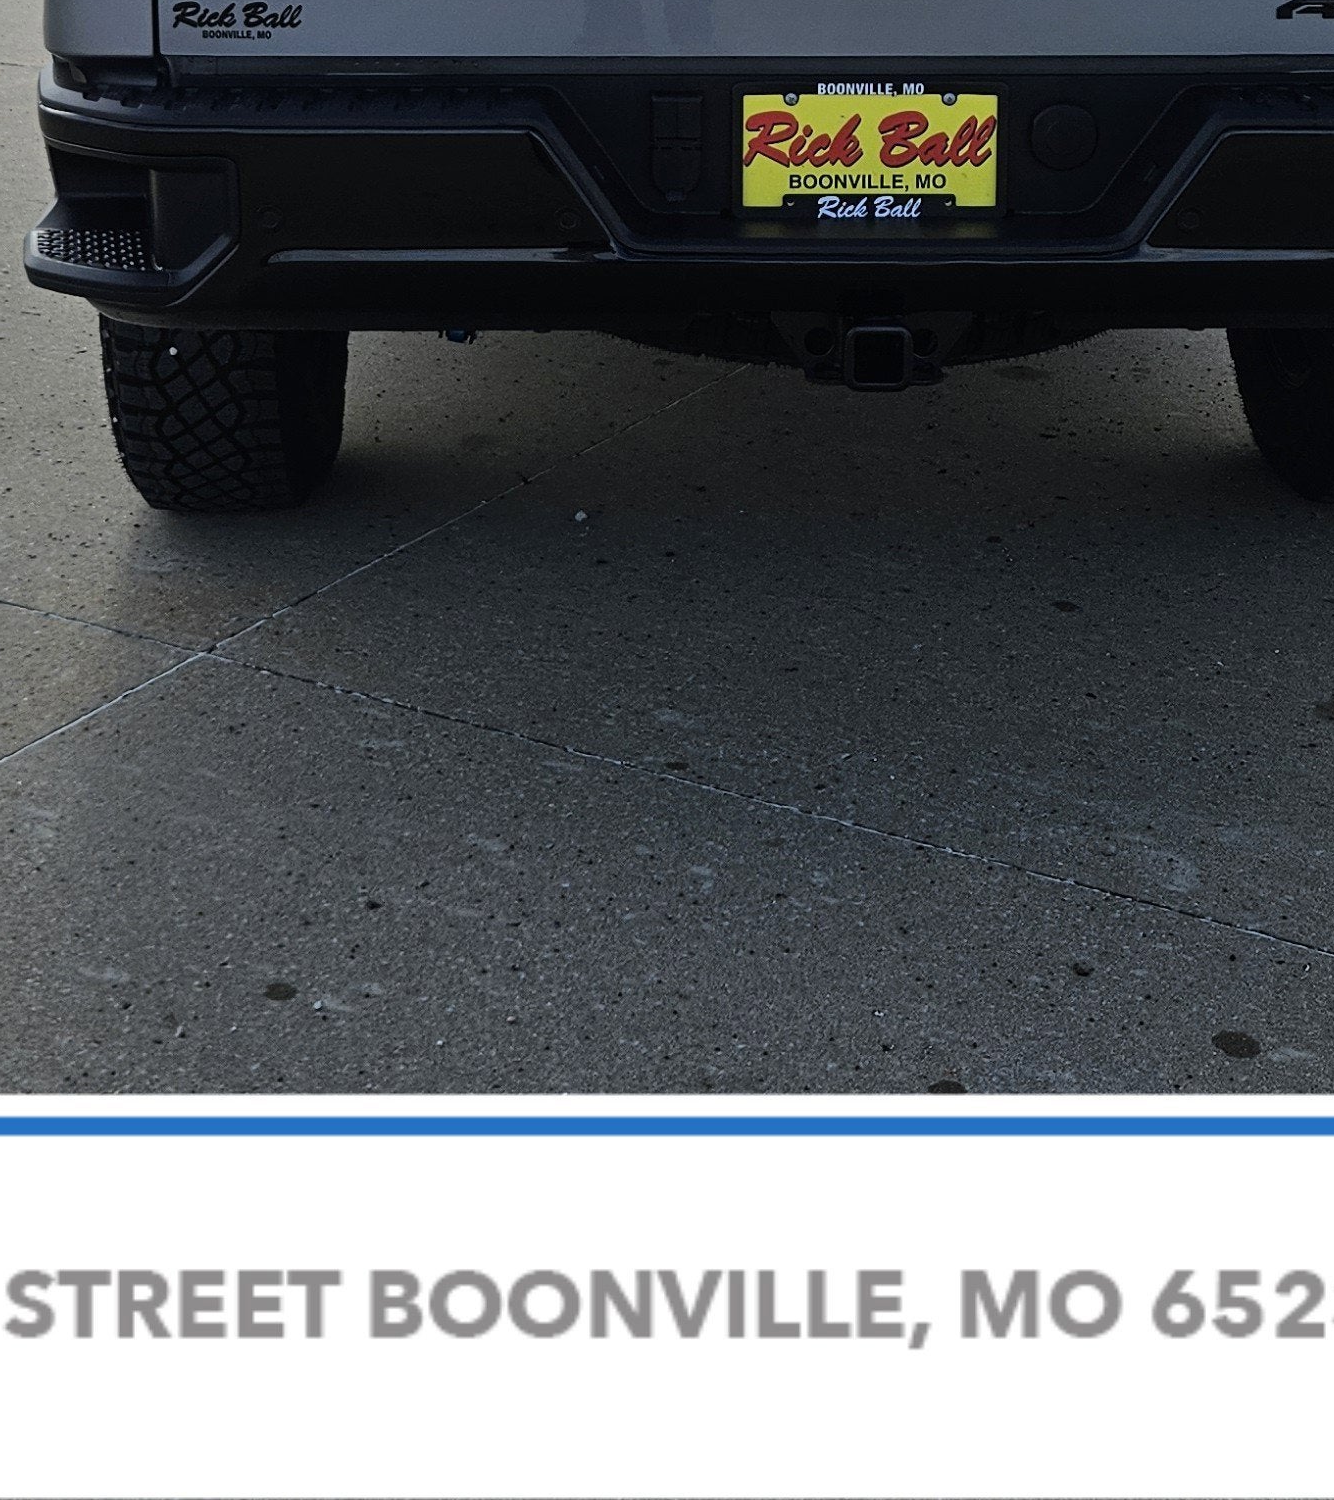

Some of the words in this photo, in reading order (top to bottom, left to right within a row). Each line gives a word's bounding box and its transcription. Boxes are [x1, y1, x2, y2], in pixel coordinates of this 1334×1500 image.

[172, 1, 237, 28] Rick
[242, 1, 303, 28] Ball
[202, 30, 255, 40] BOONVILLE,
[257, 30, 272, 40] MO
[817, 83, 897, 96] BOONVILLE,
[902, 83, 925, 95] MO
[743, 111, 864, 168] Rick
[878, 111, 997, 168] Ball
[789, 174, 909, 192] BOONVILLE,
[916, 174, 947, 189] MO
[817, 195, 868, 219] Rick
[873, 195, 922, 219] Ball
